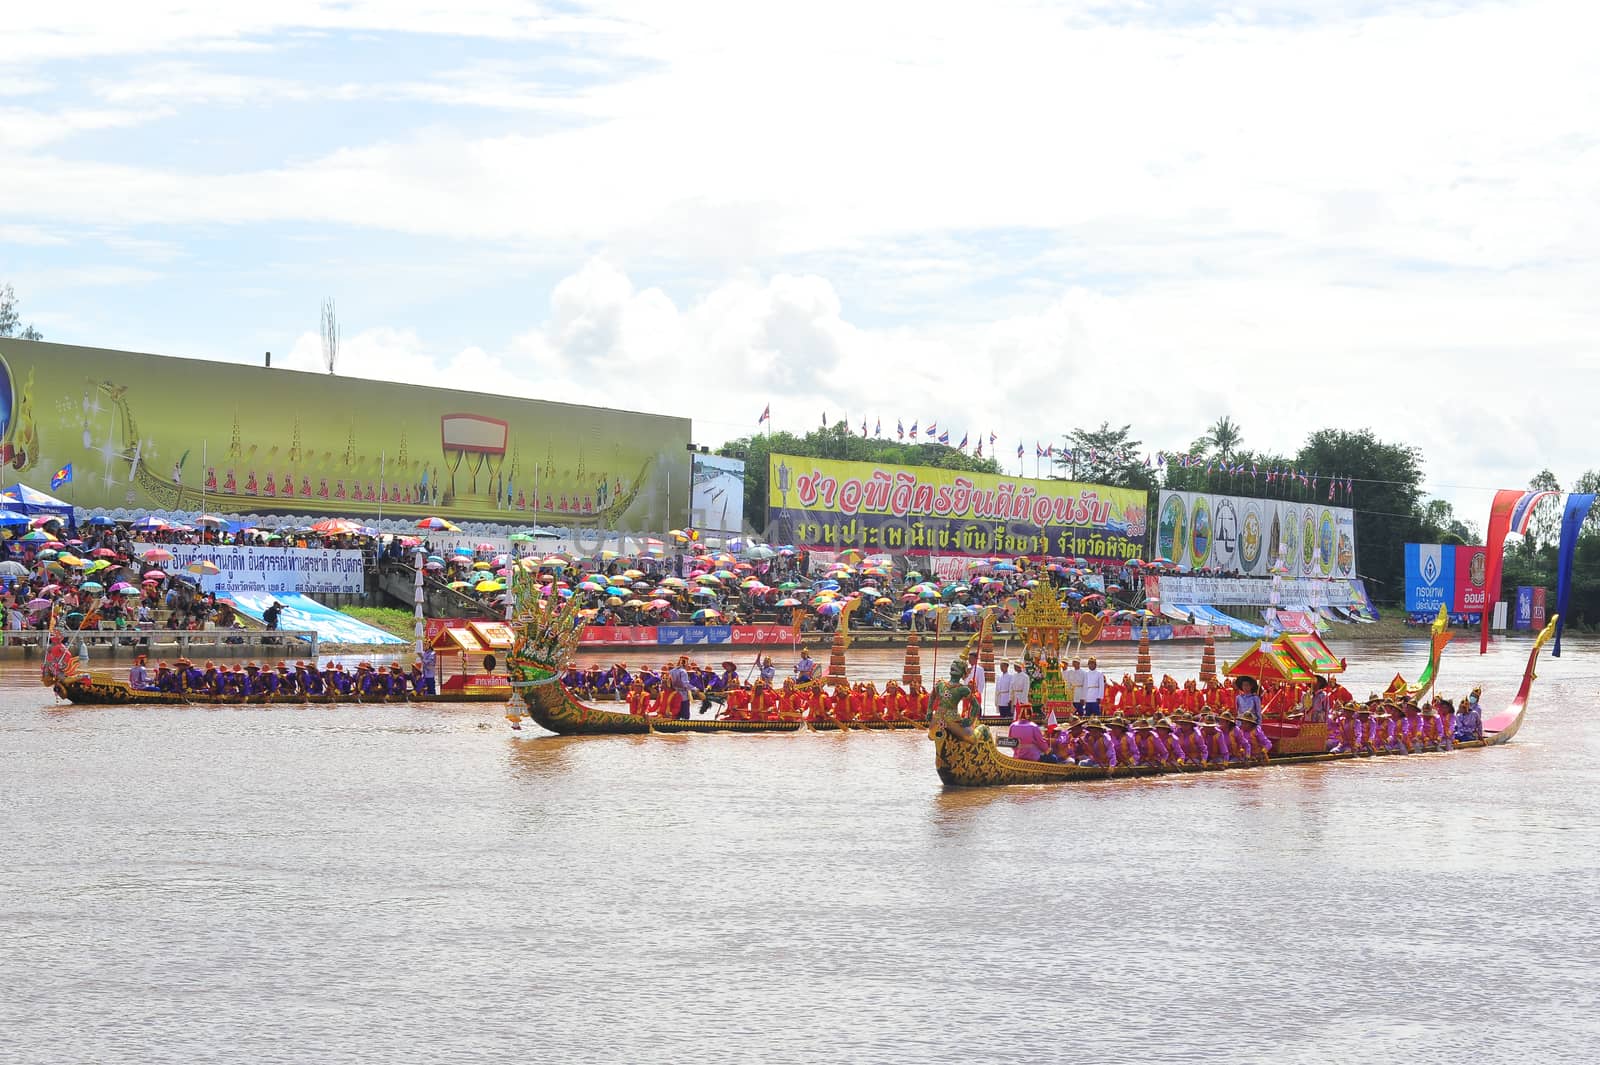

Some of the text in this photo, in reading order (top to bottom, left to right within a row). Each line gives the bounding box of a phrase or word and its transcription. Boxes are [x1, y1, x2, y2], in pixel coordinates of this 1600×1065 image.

[797, 470, 1111, 528] ชาวพิจิตรยินดีต้อนรับ
[1057, 530, 1143, 560] จังหวัดพิจิตร
[280, 583, 286, 592] 2
[355, 584, 360, 593] 3
